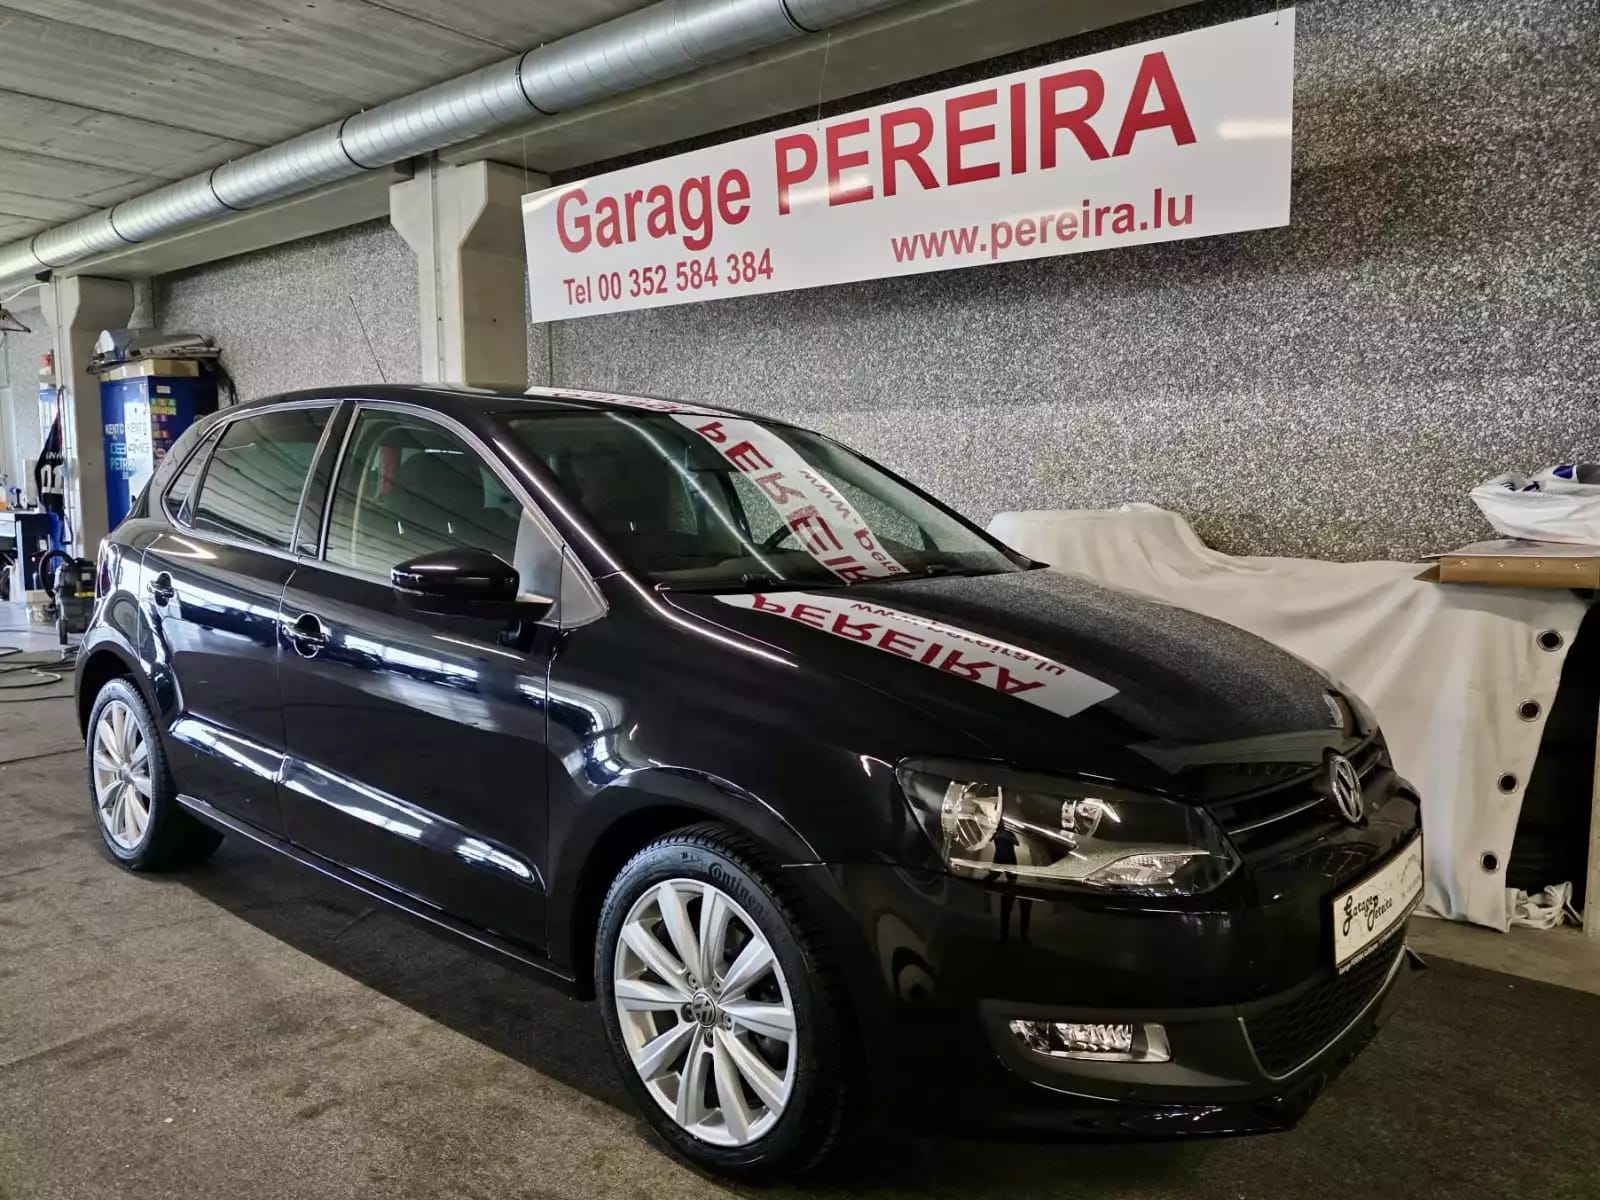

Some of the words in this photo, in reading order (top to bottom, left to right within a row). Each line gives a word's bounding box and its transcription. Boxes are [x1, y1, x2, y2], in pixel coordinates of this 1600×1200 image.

[556, 168, 751, 253] Garage
[774, 51, 1198, 216] PEREIRA
[890, 188, 1194, 263] www.pereira.lu
[563, 276, 592, 306] Tel
[599, 271, 622, 301] 00
[629, 264, 668, 297] 352
[676, 256, 719, 291] 584
[726, 247, 774, 284] 384
